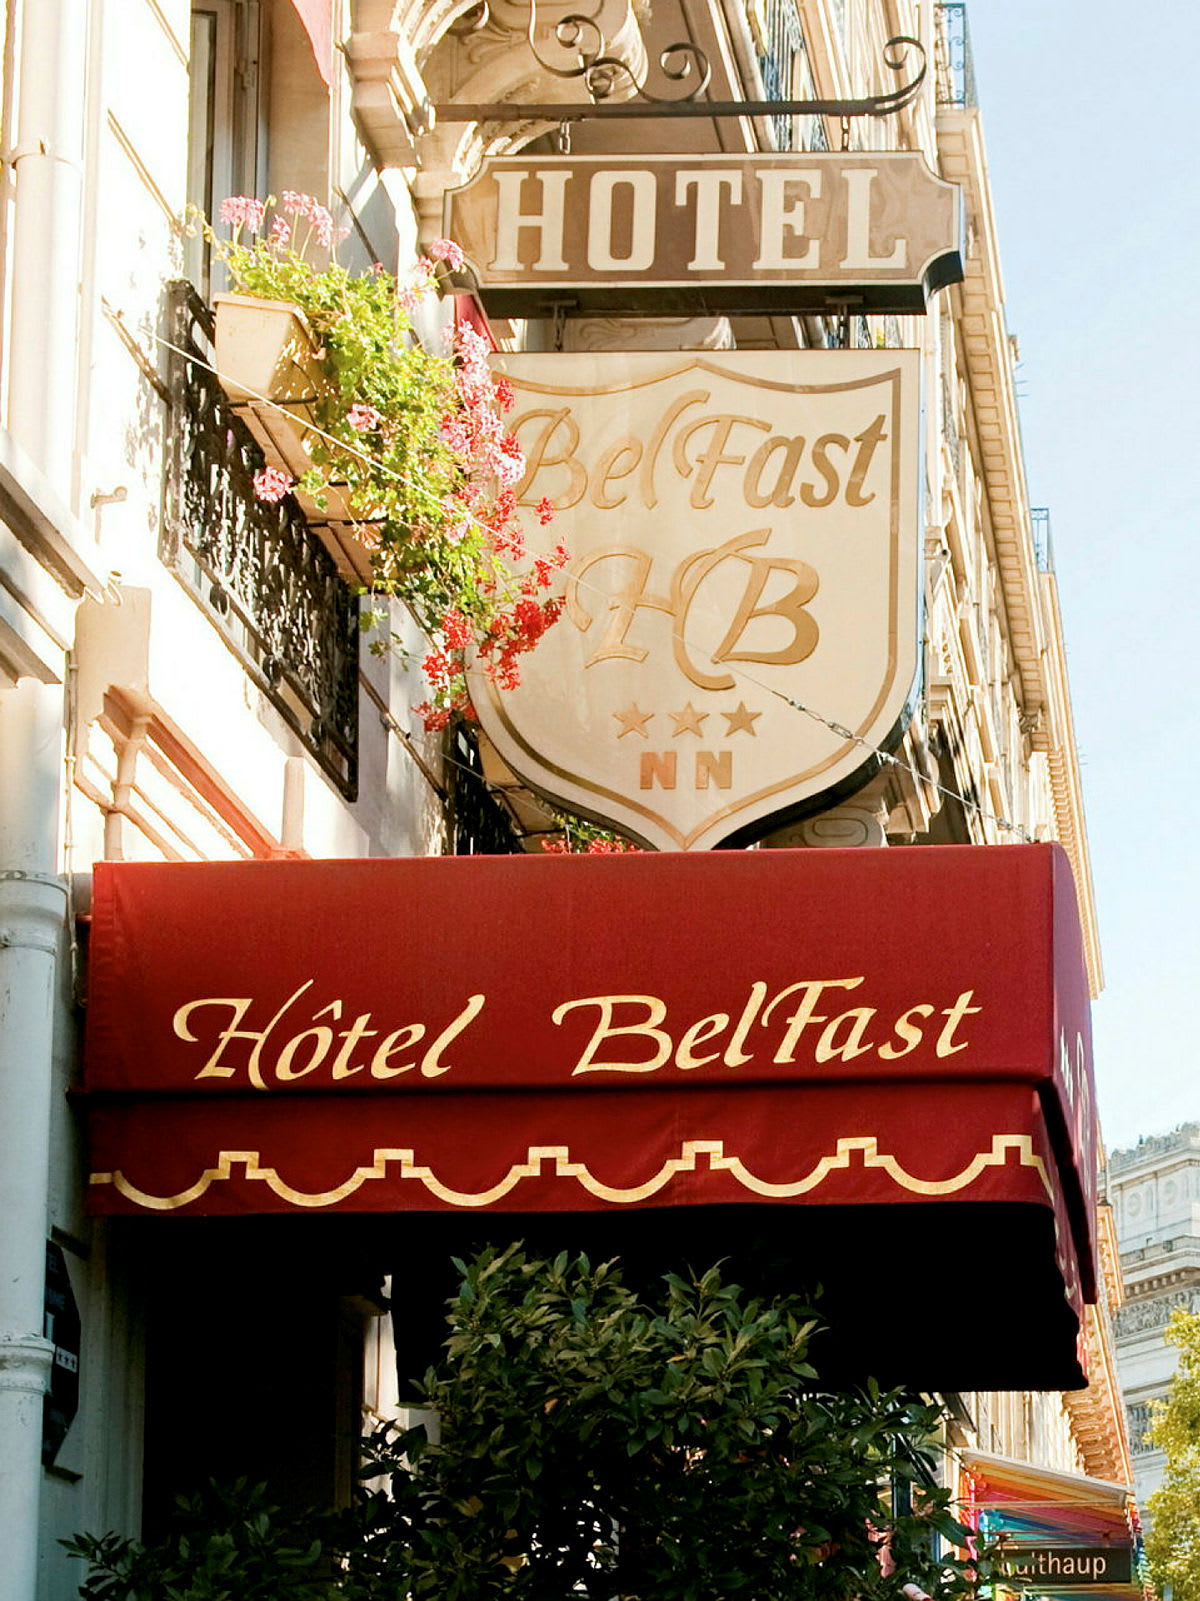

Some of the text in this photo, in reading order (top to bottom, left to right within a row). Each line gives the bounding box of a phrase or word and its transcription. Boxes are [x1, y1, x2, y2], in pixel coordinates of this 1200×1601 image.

[488, 168, 907, 271] HOTEL
[505, 391, 888, 511] BelFast
[173, 976, 982, 1091] Hôtel BelFast
